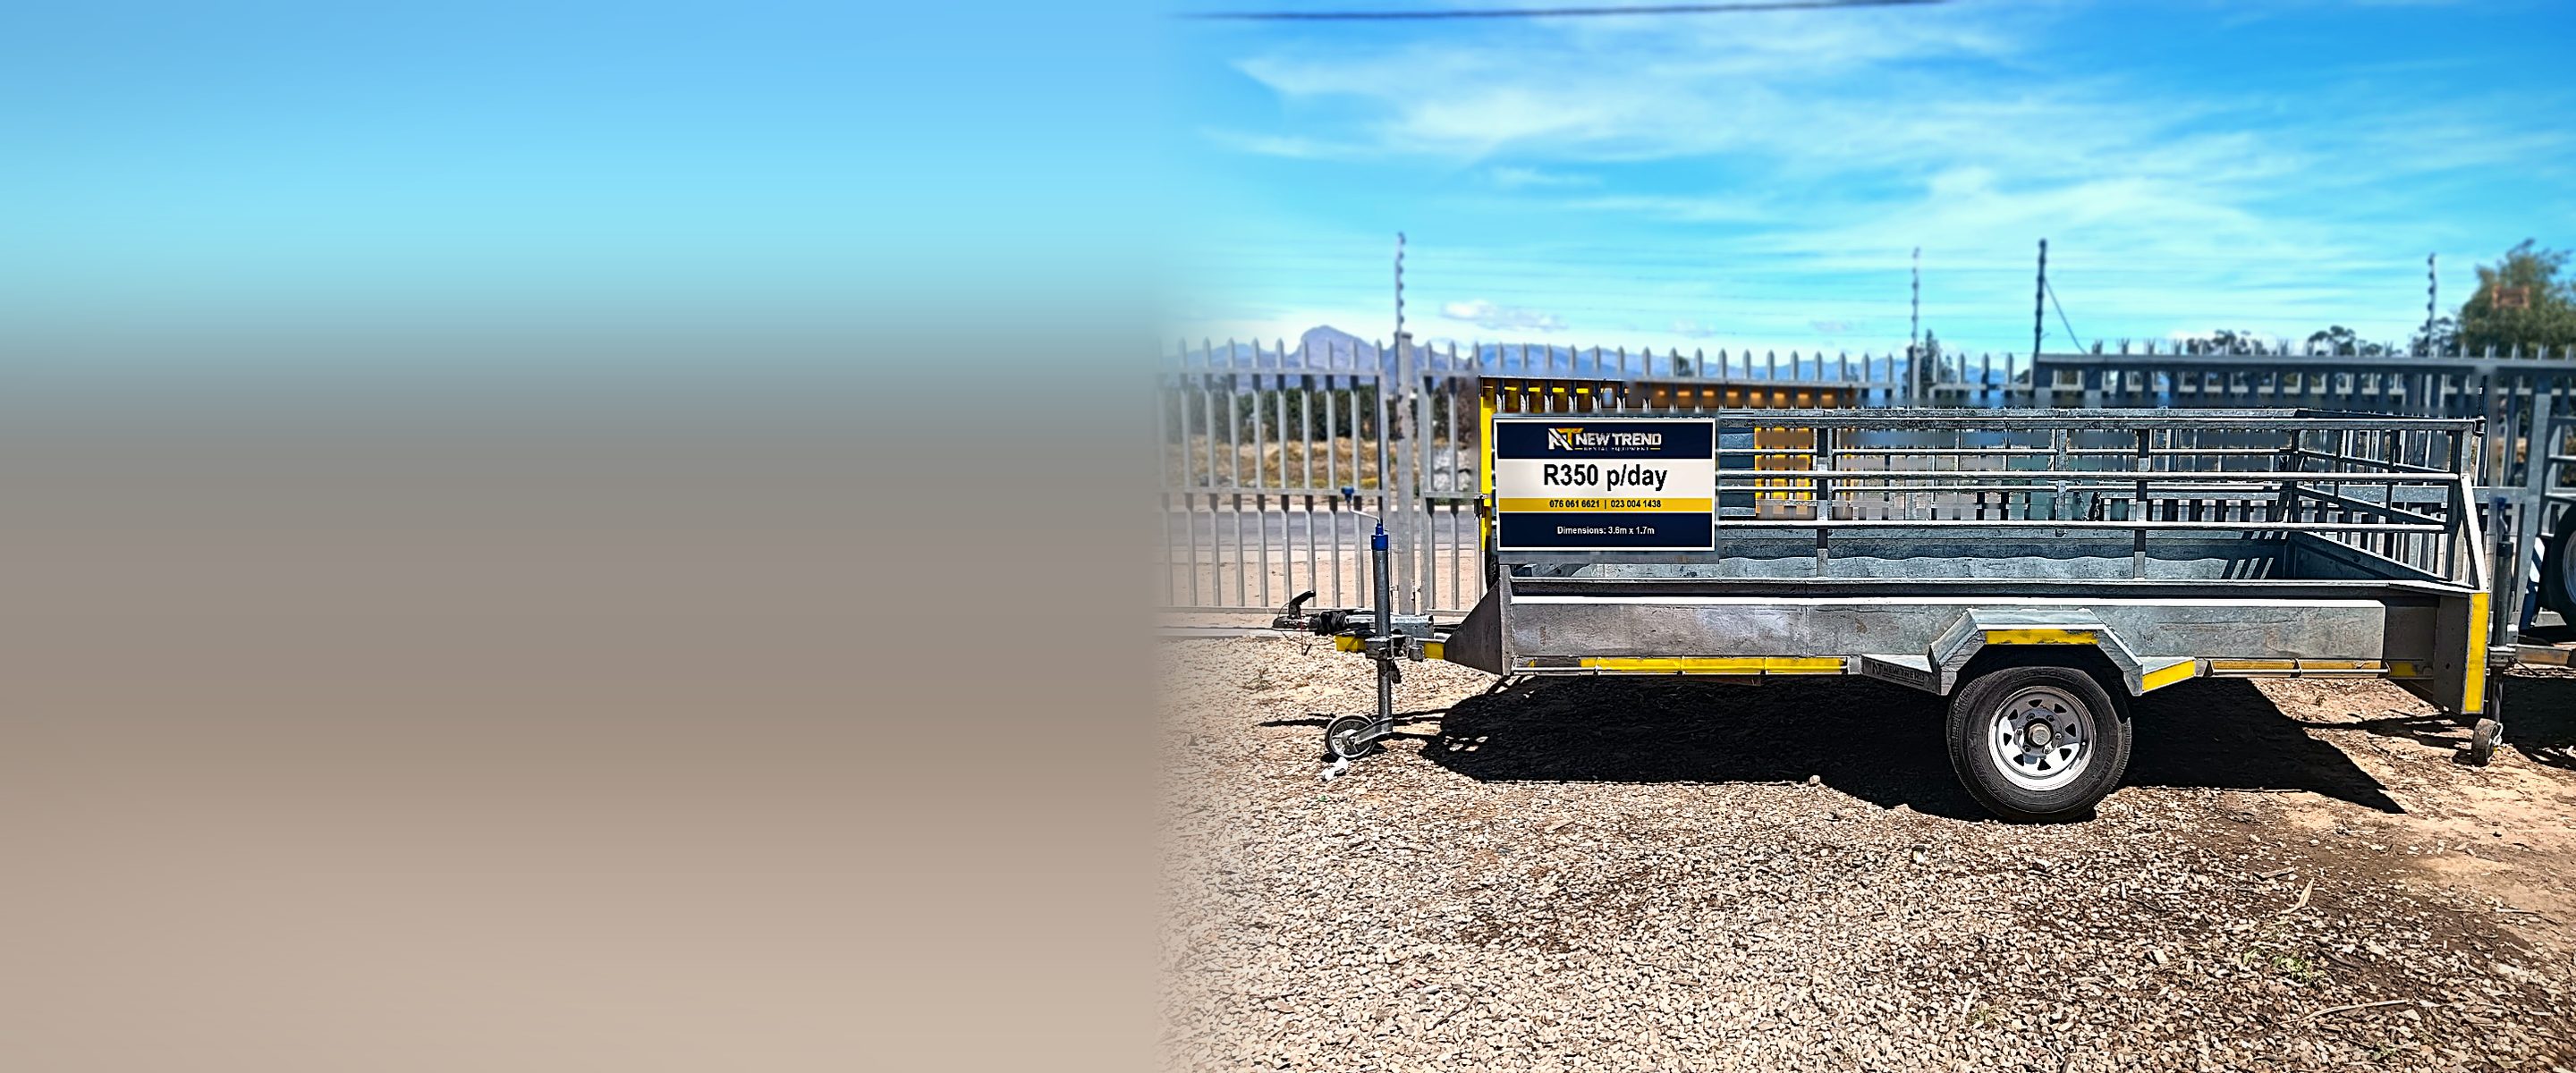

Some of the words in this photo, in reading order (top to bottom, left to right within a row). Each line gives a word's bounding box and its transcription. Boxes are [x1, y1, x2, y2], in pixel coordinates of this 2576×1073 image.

[1575, 433, 1611, 445] NEW
[1612, 433, 1662, 445] TREND
[1544, 464, 1598, 486] R350
[1607, 464, 1667, 491] p/day
[1549, 500, 1563, 508] 076
[1565, 500, 1579, 508] 061
[1581, 500, 1599, 508] 6621
[1611, 500, 1624, 508] 023
[1627, 500, 1640, 508] 004
[1643, 500, 1661, 508] 1438
[1557, 527, 1606, 535] Dimensions:
[1608, 527, 1627, 535] 3.6m
[1636, 527, 1655, 535] 1.7m
